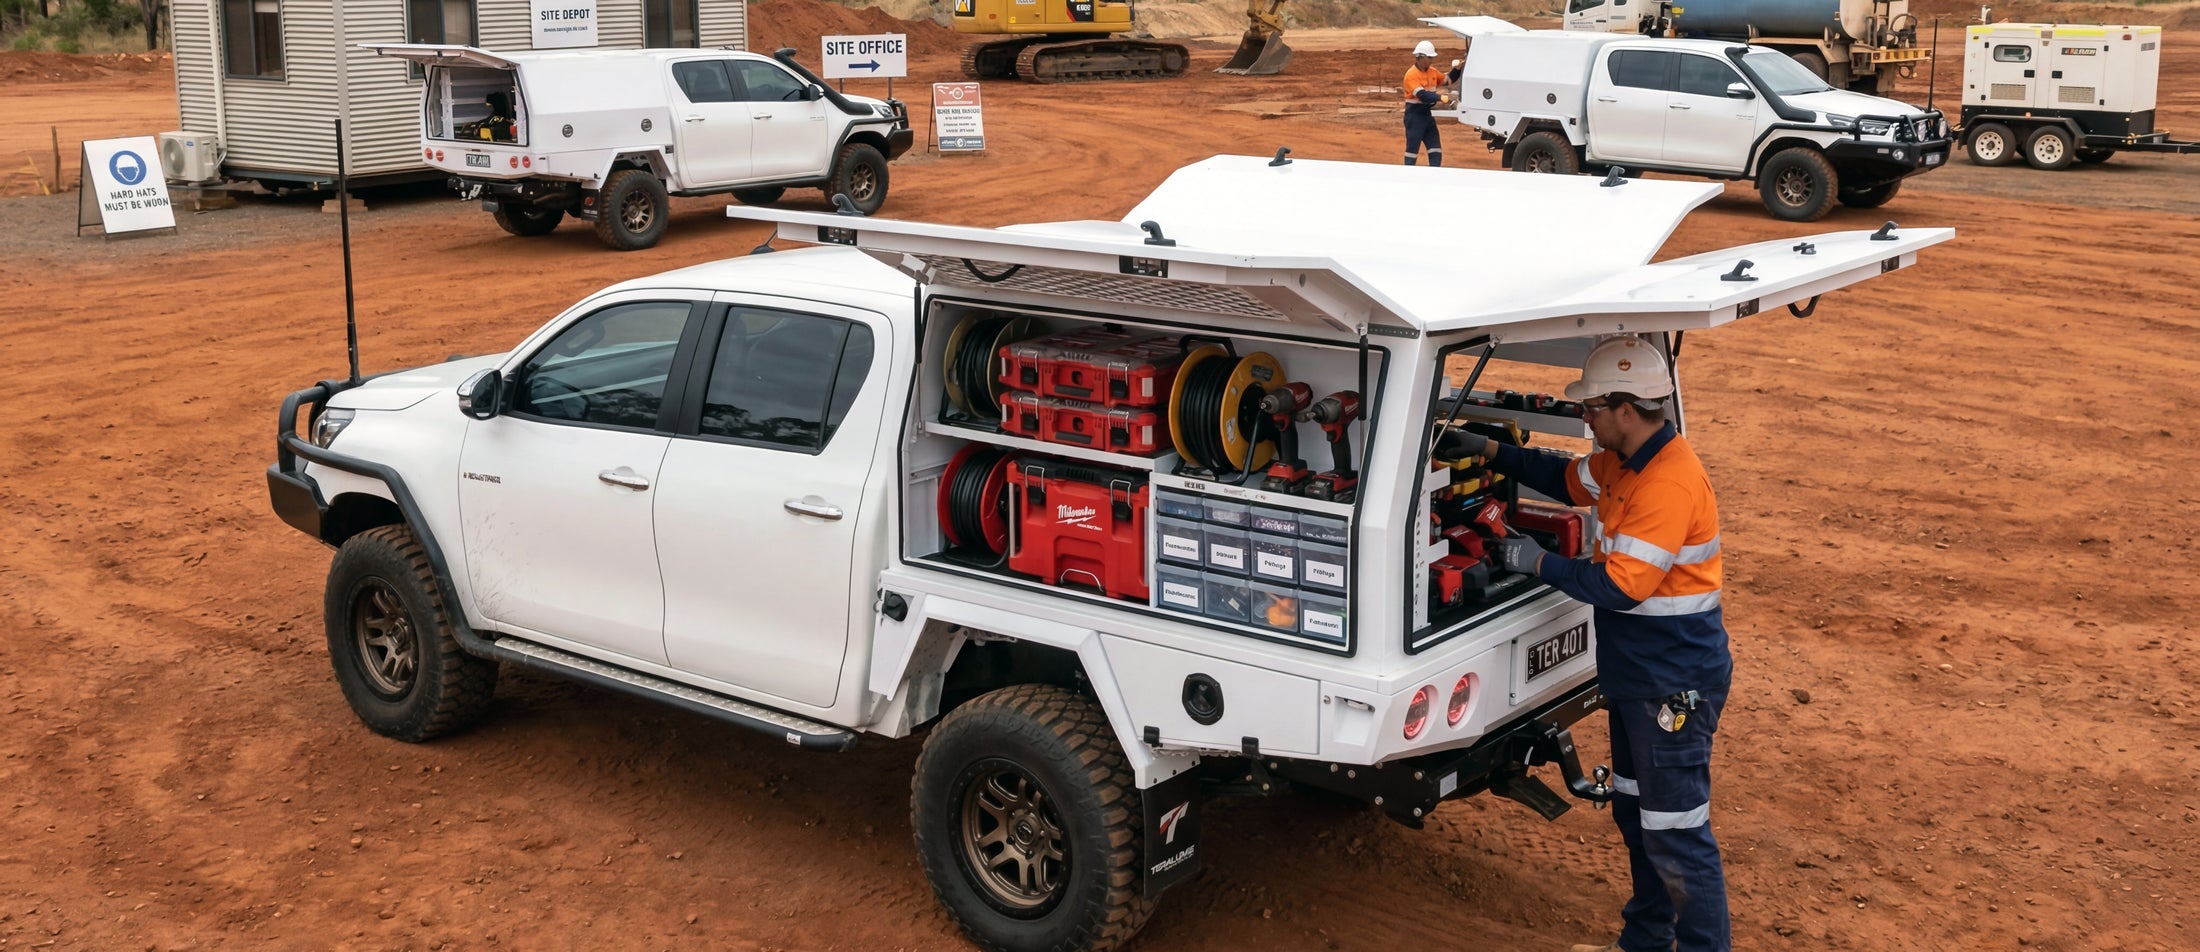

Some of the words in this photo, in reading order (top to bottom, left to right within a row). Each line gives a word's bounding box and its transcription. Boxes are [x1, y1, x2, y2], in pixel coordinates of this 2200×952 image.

[541, 10, 560, 20] SITE
[563, 9, 590, 19] DEPOT
[826, 41, 854, 55] SITE
[859, 40, 902, 54] OFFICE
[110, 190, 133, 199] HARD
[136, 188, 157, 197] HATS
[104, 201, 128, 211] MUST
[131, 200, 142, 209] BE
[1537, 638, 1559, 670] TER
[1562, 626, 1583, 657] 401
